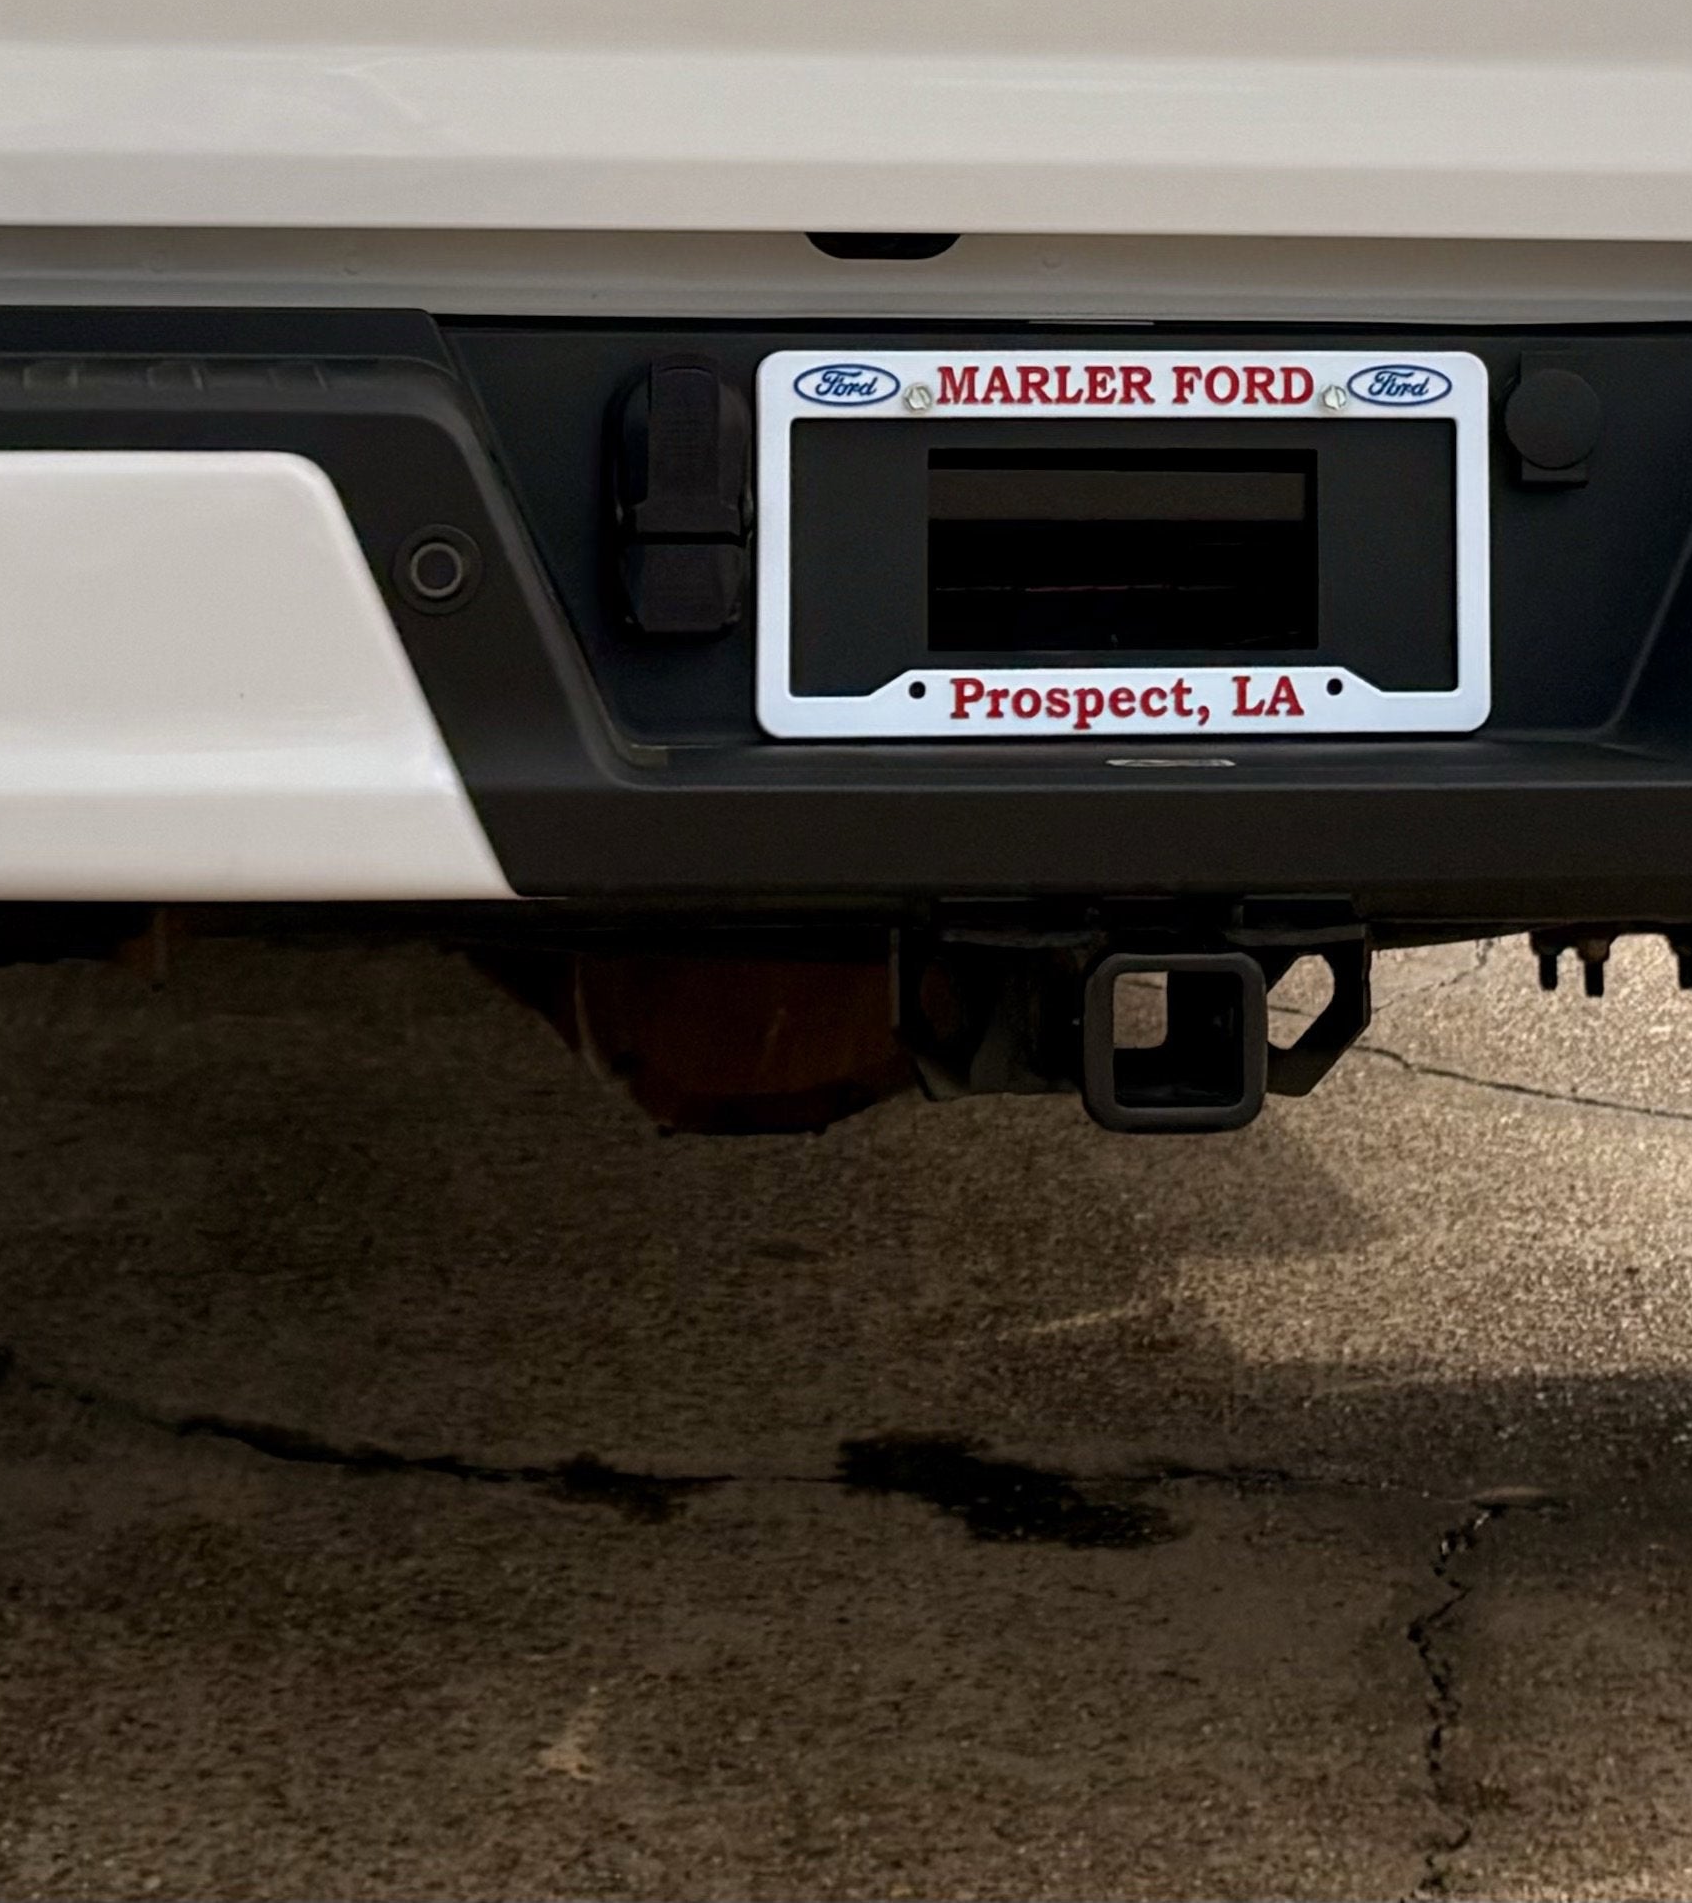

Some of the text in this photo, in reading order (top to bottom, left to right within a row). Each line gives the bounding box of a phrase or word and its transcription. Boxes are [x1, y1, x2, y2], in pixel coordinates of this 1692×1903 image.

[815, 370, 878, 396] Ford
[938, 366, 1314, 405] MARLER FORD
[1368, 370, 1430, 397] Ford
[952, 676, 1304, 730] Prospect, LA
